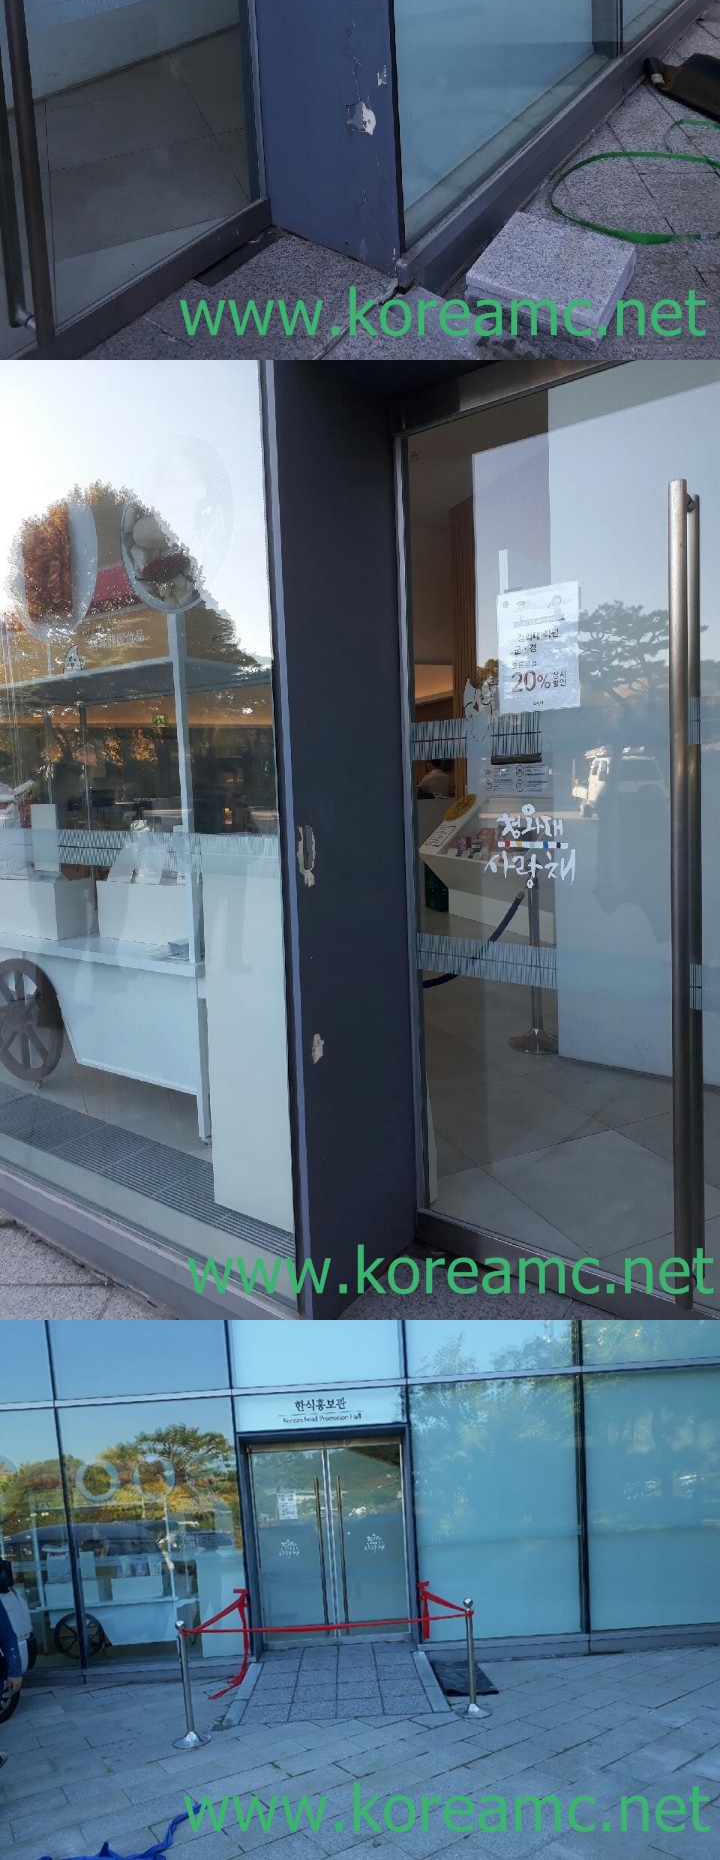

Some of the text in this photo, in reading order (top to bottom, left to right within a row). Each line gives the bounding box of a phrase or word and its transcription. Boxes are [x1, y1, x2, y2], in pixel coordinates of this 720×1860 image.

[511, 670, 551, 693] 20%
[552, 670, 567, 679] 상시
[293, 1397, 347, 1412] 한식홍보관
